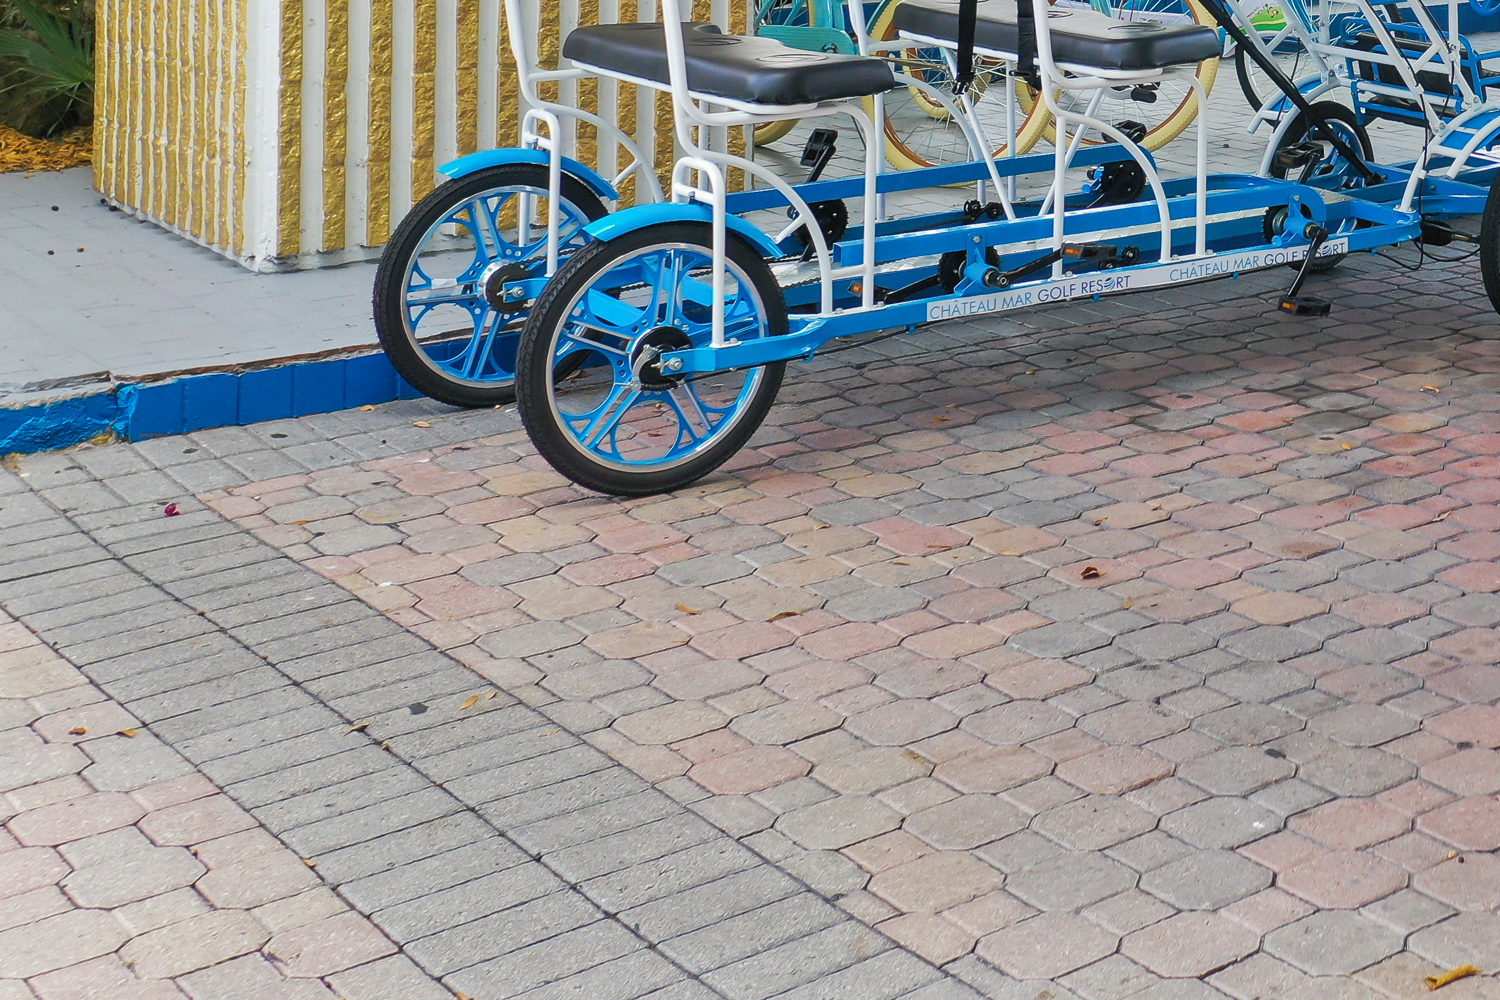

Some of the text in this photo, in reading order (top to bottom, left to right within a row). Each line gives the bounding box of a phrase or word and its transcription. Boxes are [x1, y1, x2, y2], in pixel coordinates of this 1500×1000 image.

[1169, 263, 1229, 282] CHÂTEAU
[1233, 256, 1260, 271] MAR
[1264, 249, 1299, 267] GOLF
[929, 275, 1131, 320] CHÂTEAU MAR GOLF RESORT
